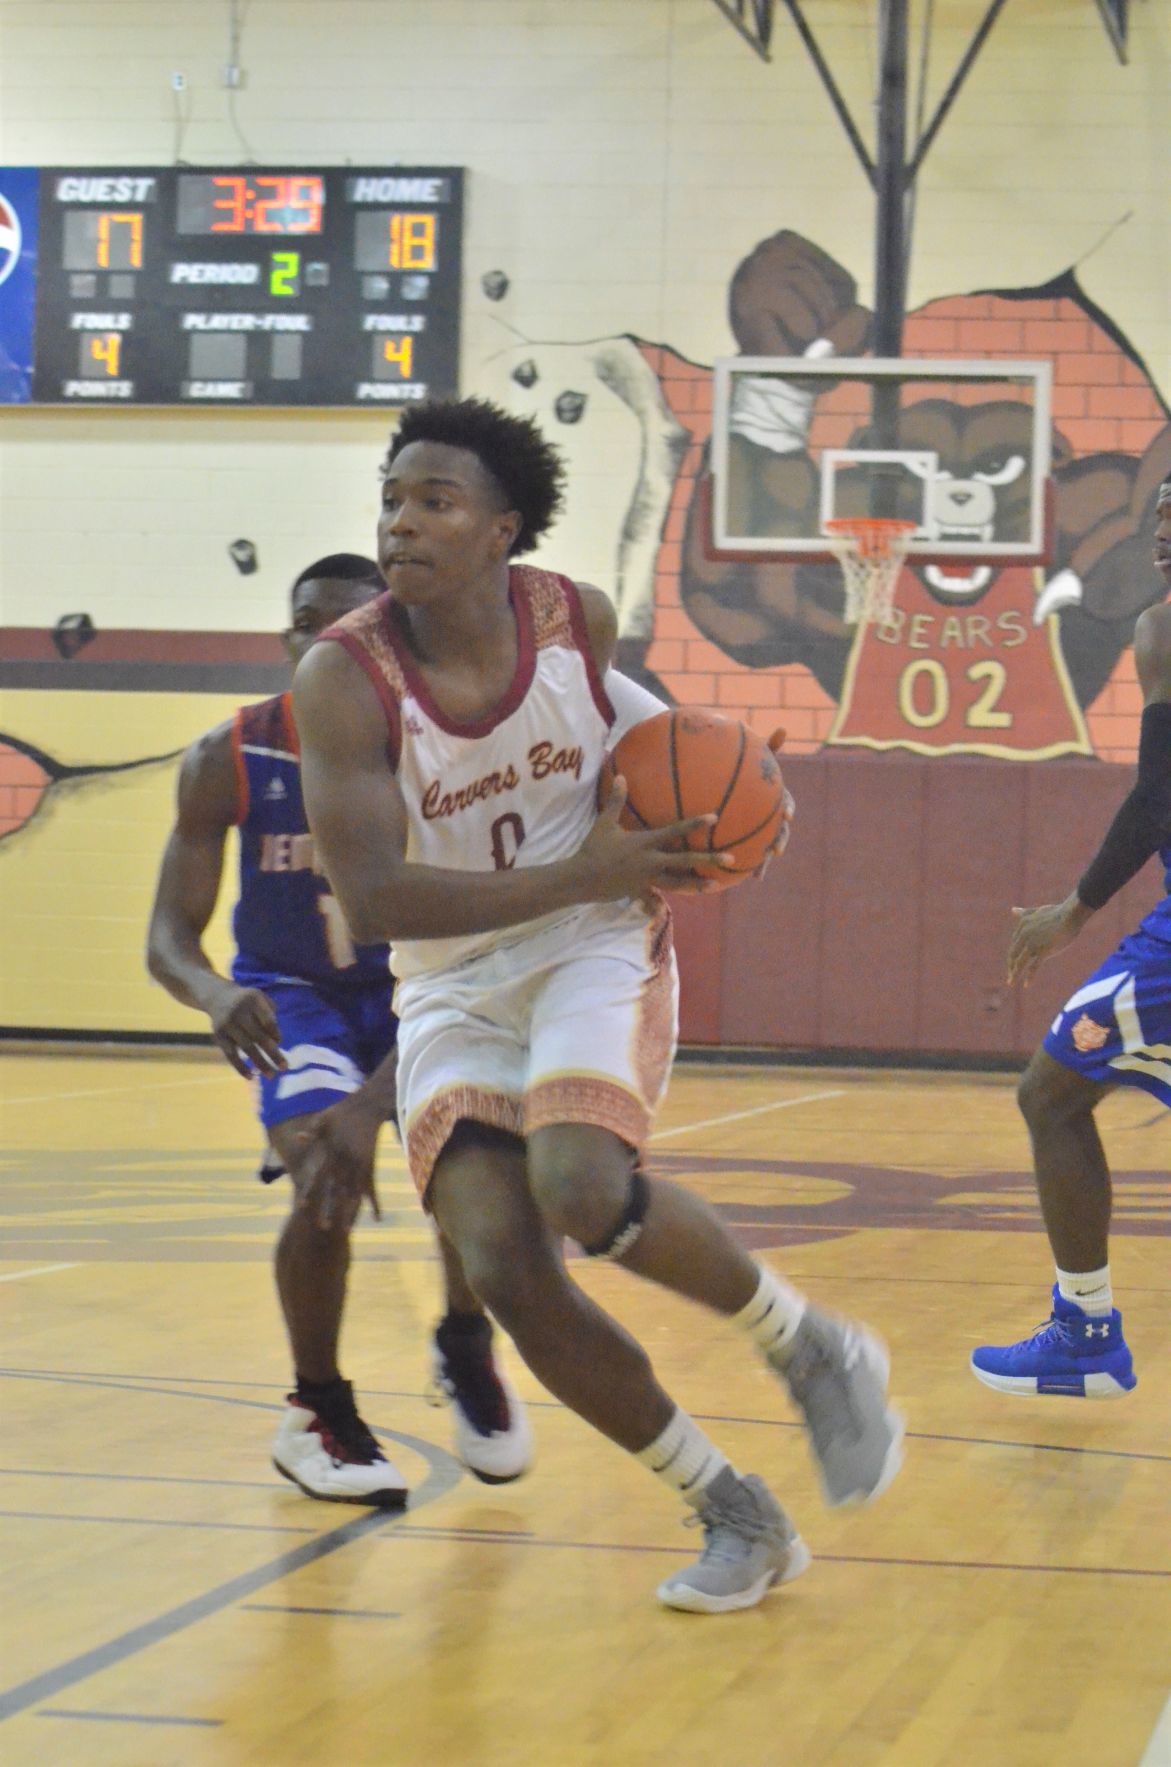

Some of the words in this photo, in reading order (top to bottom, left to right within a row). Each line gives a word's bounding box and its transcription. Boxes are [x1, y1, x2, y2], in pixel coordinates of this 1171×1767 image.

[56, 177, 155, 201] GUEST
[211, 176, 322, 232] 3:29
[353, 179, 442, 202] HOME
[97, 212, 143, 268] 17
[389, 213, 436, 269] 18
[170, 264, 259, 284] PERIOD
[270, 252, 299, 296] 2
[71, 313, 132, 331] FOULS
[182, 314, 312, 331] PLAYER-FOUL
[363, 315, 425, 331] FOULS
[92, 333, 120, 376] 4
[384, 336, 412, 378] 4
[64, 380, 134, 398] POINTS
[188, 382, 246, 398] GAME
[356, 383, 427, 399] POINTS
[875, 608, 1028, 649] BEARS
[422, 764, 519, 820] Carvers
[528, 741, 583, 781] Bay
[491, 812, 526, 871] 0
